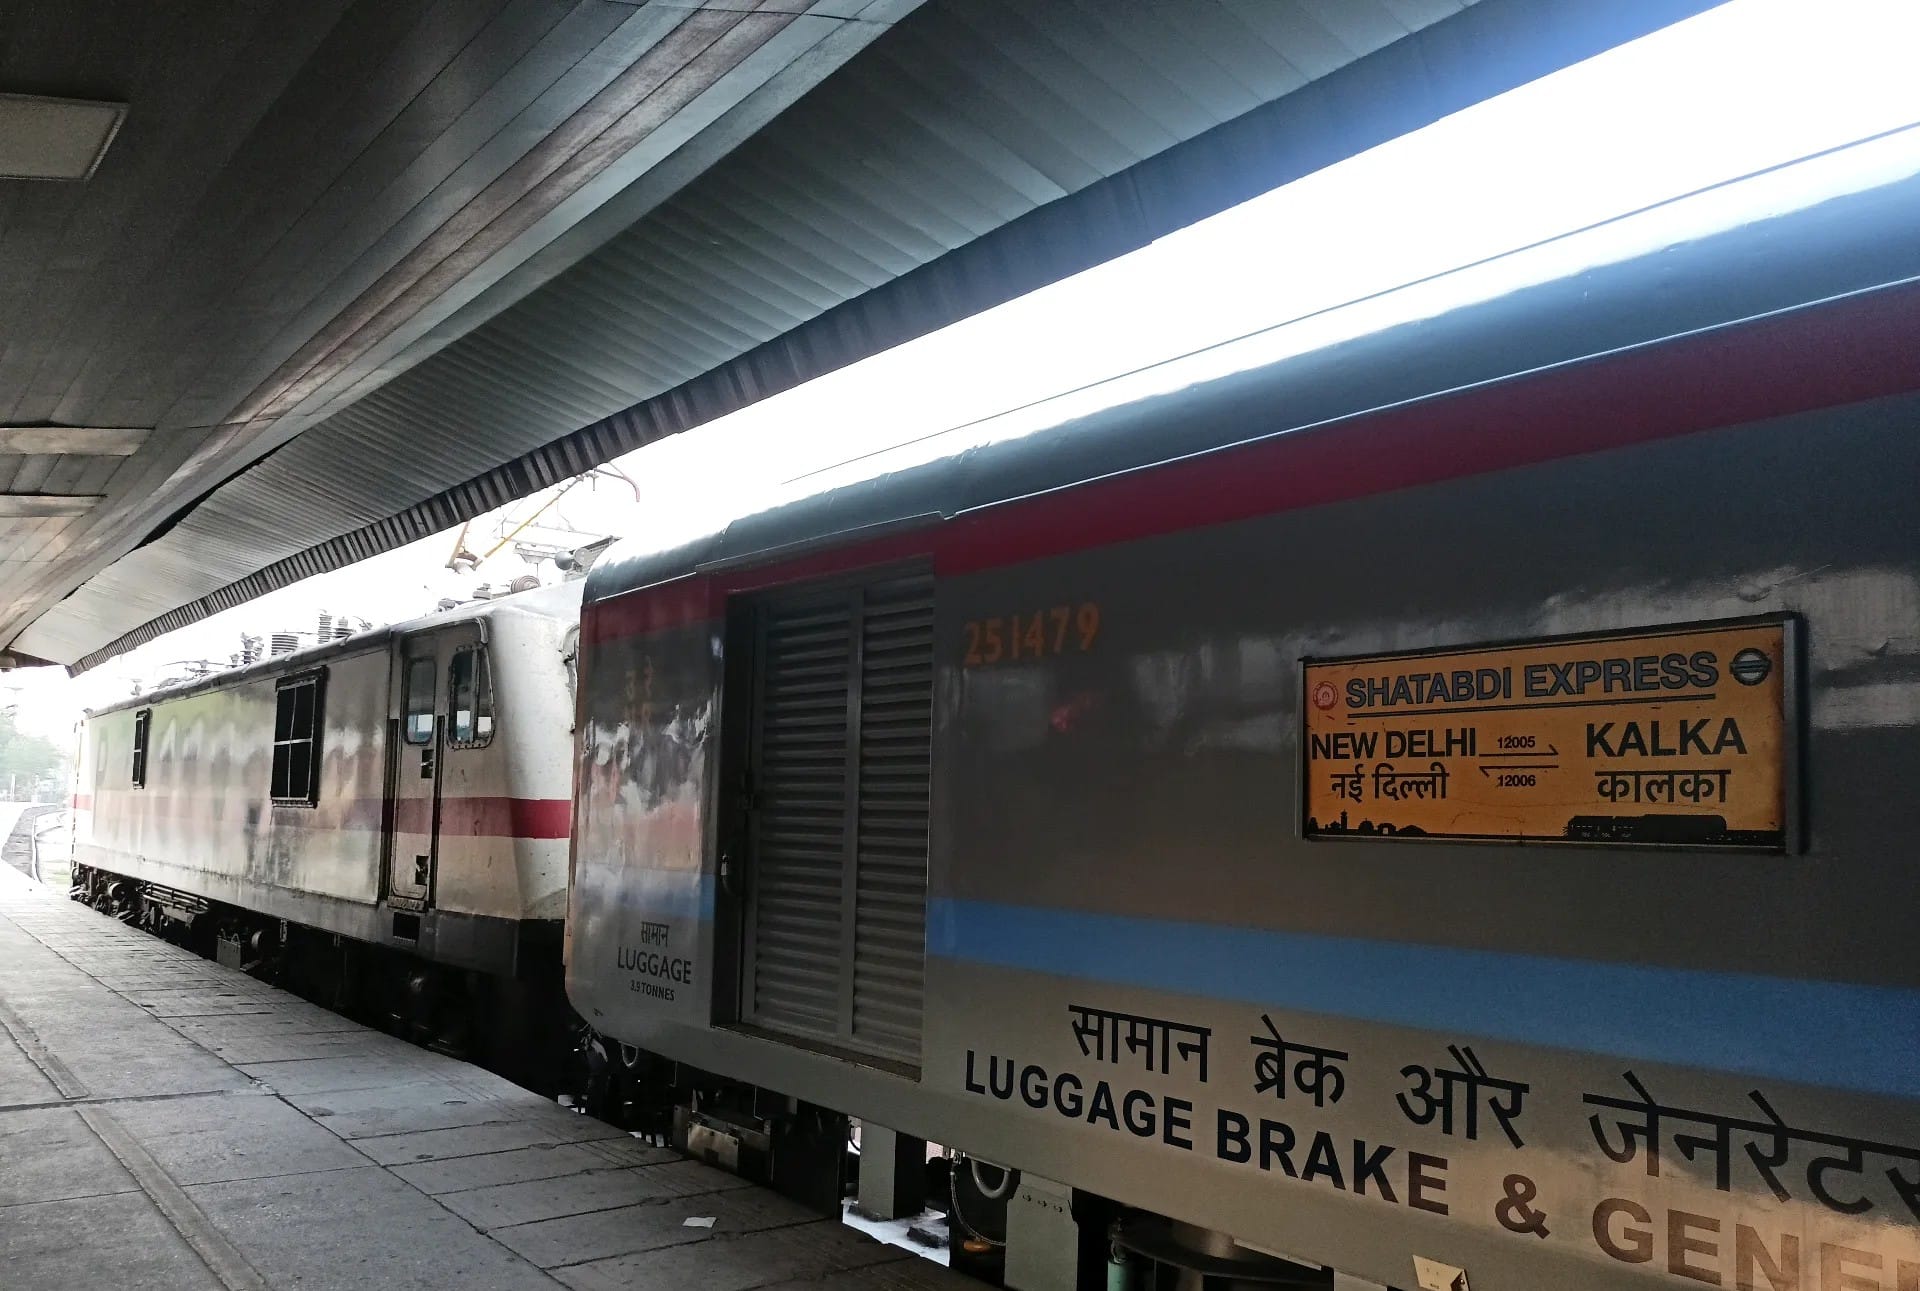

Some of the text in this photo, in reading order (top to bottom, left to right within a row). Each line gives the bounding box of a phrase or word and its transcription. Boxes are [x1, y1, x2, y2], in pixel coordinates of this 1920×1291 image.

[962, 603, 1100, 666] 251479
[1345, 651, 1720, 709] SHATABDI EXPRESS
[1311, 727, 1477, 760] NEW DELHI
[1497, 735, 1536, 749] 12005
[1586, 718, 1748, 758] KALKA
[1330, 762, 1450, 803] नई दिल्ली
[1497, 774, 1536, 788] 12006
[1595, 768, 1732, 804] कालका
[641, 921, 670, 948] सामान
[617, 947, 692, 985] LUGGAGE
[641, 982, 675, 1001] TONNES
[1068, 1004, 1212, 1083] सामान
[1250, 1014, 1349, 1108] ब्रेक
[1396, 1044, 1530, 1149] और
[965, 1050, 1920, 1291] LUGGAGE BRAKE & GENE
